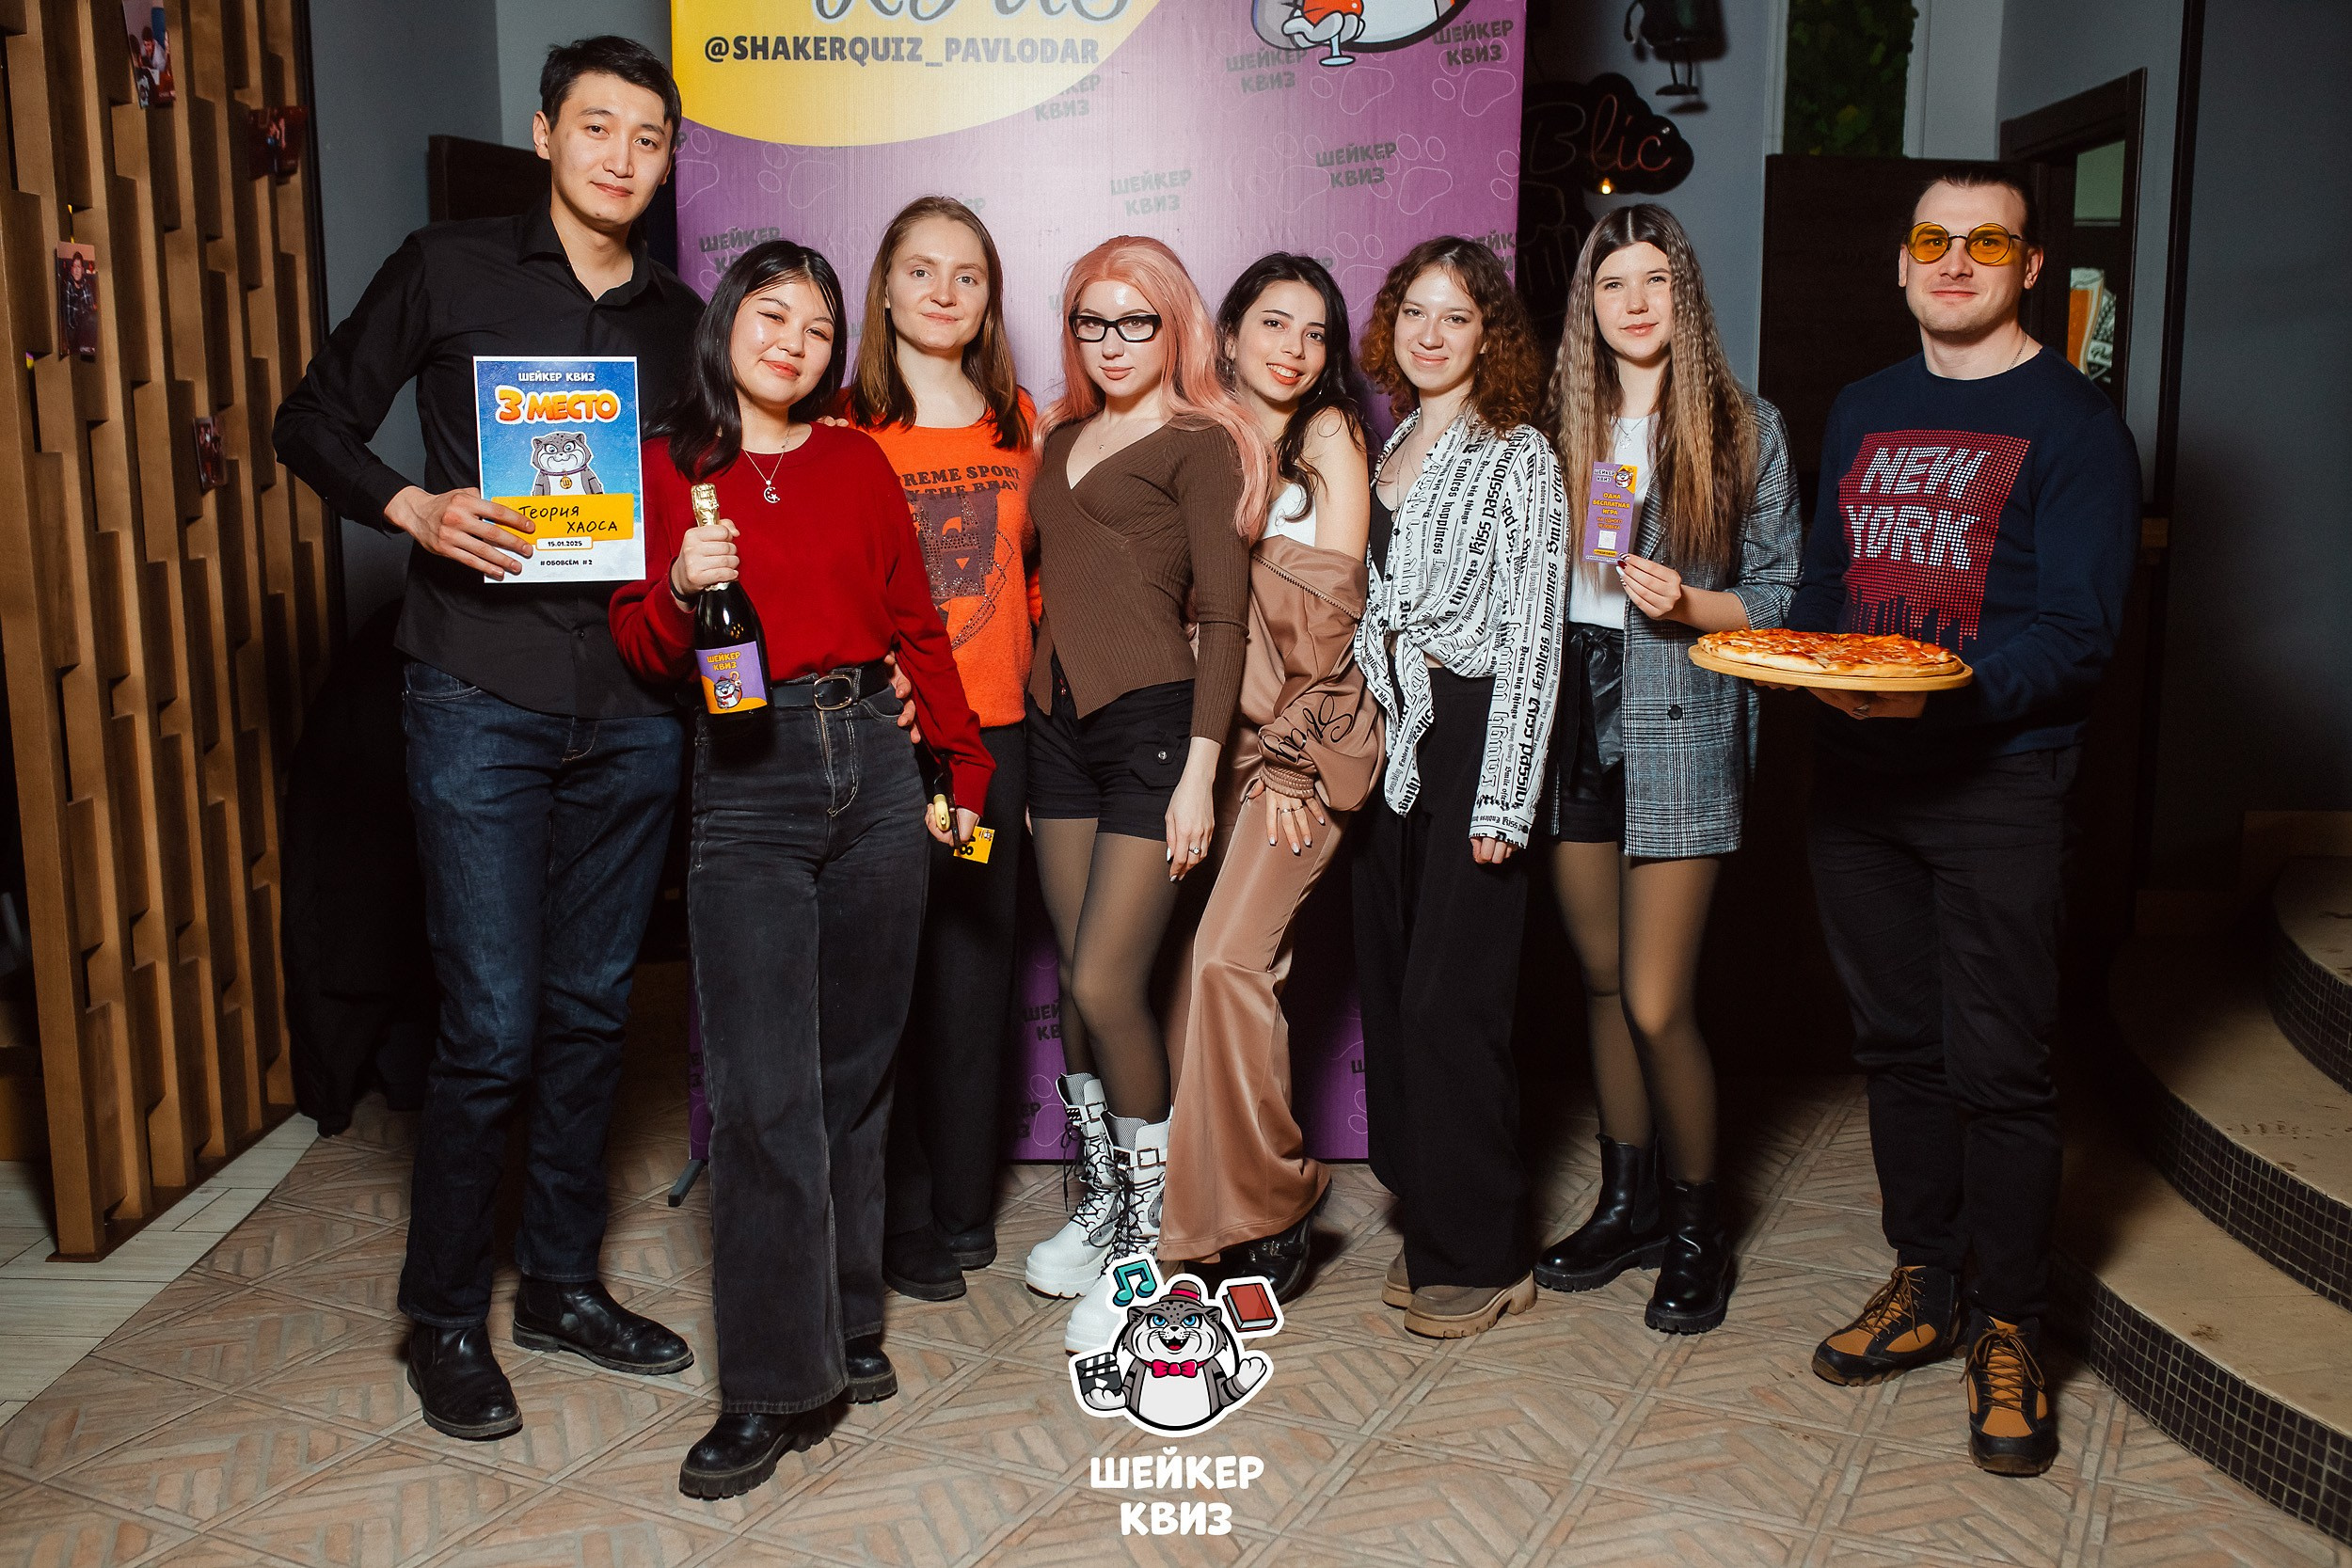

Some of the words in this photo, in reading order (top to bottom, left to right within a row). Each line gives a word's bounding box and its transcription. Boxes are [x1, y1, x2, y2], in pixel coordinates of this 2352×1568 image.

[1433, 19, 1514, 47] ШЕЙКЕР
[704, 35, 1100, 68] @SHAKERQUIZ_PAVLODAR
[1226, 47, 1308, 72] ШЕЙКЕР
[1446, 43, 1502, 67] КВИЗ
[1240, 71, 1296, 93] КВИЗ
[1035, 99, 1089, 122] КВИЗ
[1316, 141, 1397, 167] ШЕЙКЕР
[1110, 168, 1192, 196] ШЕЙКЕР
[1329, 166, 1386, 189] КВИЗ
[1125, 193, 1181, 216] КВИЗ
[517, 371, 562, 382] ШЕЙКЕР
[565, 372, 595, 382] КВИЗ
[498, 388, 522, 421] 3
[526, 390, 618, 421] МЕСТО
[900, 468, 962, 487] REME
[1448, 458, 1473, 498] Endless
[1859, 447, 1992, 499] NEW
[1468, 520, 1492, 556] Kiss
[1480, 431, 1531, 519] passionately
[1592, 499, 1630, 509] БЕСПЛАТНАЯ
[566, 520, 618, 533] ХАОСА
[1432, 500, 1455, 555] happiness
[1545, 508, 1563, 557] Smile
[1845, 505, 1980, 570] YORK
[1539, 562, 1558, 632] happiness
[707, 651, 741, 663] ШЕЙКЕР
[712, 661, 737, 671] КВИЗ
[1532, 637, 1550, 691] Endless
